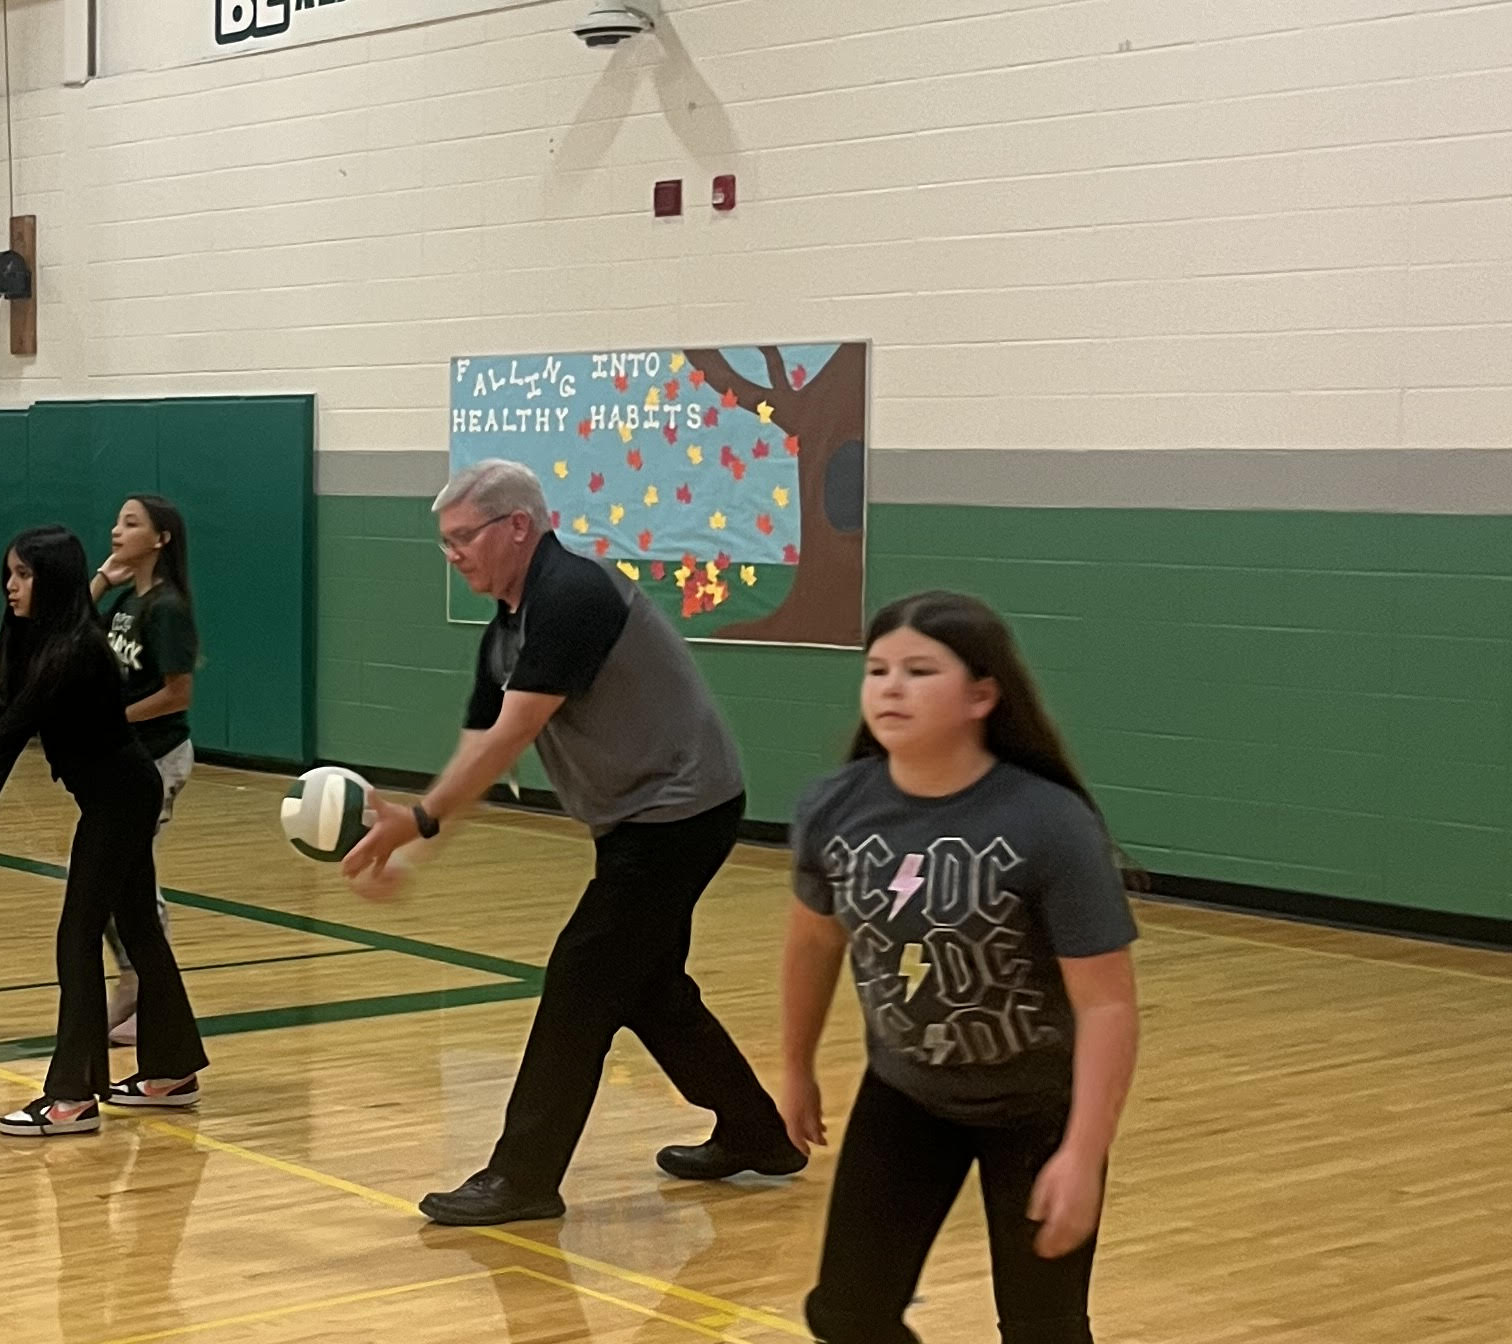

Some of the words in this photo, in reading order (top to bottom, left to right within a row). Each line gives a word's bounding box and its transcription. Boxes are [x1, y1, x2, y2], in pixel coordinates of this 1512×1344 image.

[456, 356, 576, 399] FALLING
[592, 352, 660, 379] INTO
[452, 408, 569, 433] HEALTHY
[590, 403, 702, 429] HABITS
